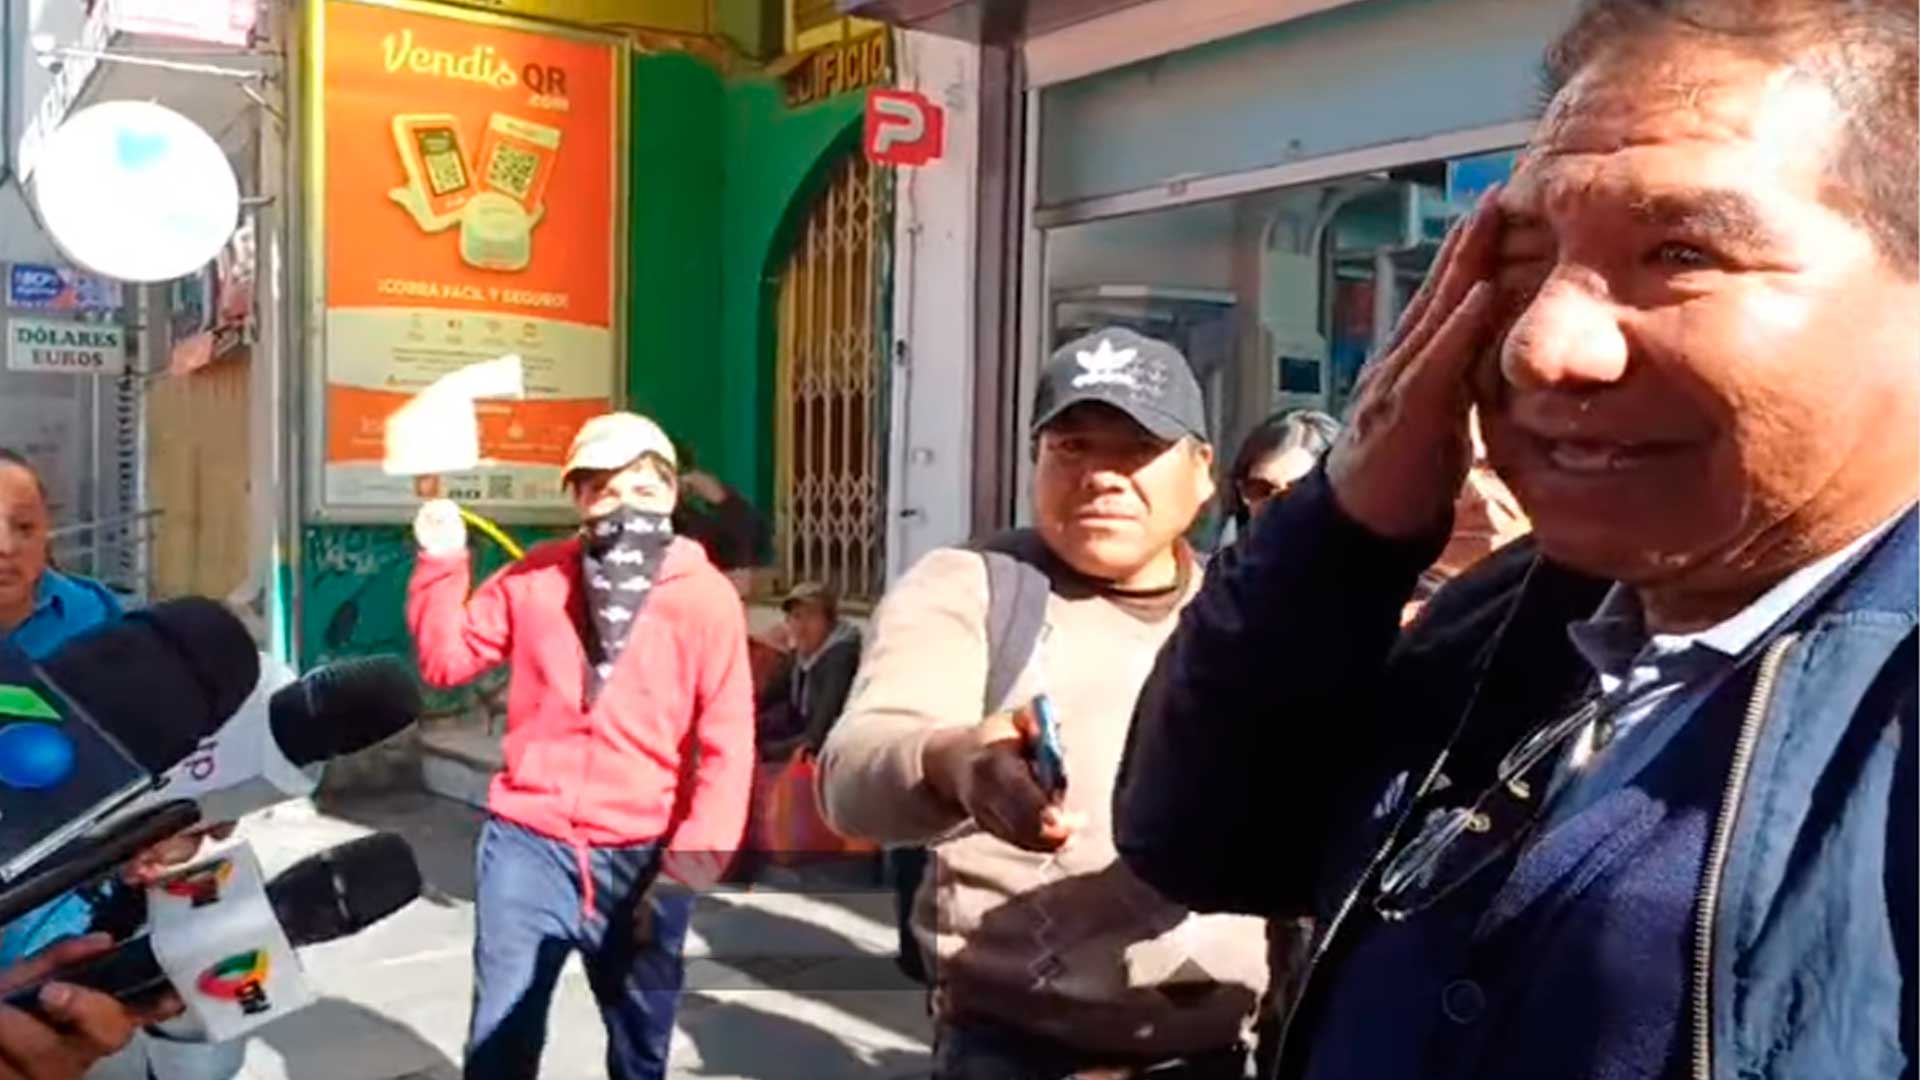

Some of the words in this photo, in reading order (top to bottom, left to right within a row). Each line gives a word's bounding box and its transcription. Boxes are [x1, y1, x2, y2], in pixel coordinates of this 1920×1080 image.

[381, 28, 518, 87] Vendis
[522, 63, 566, 94] QR
[18, 327, 118, 347] DÓLARES
[32, 351, 103, 366] EUROS
